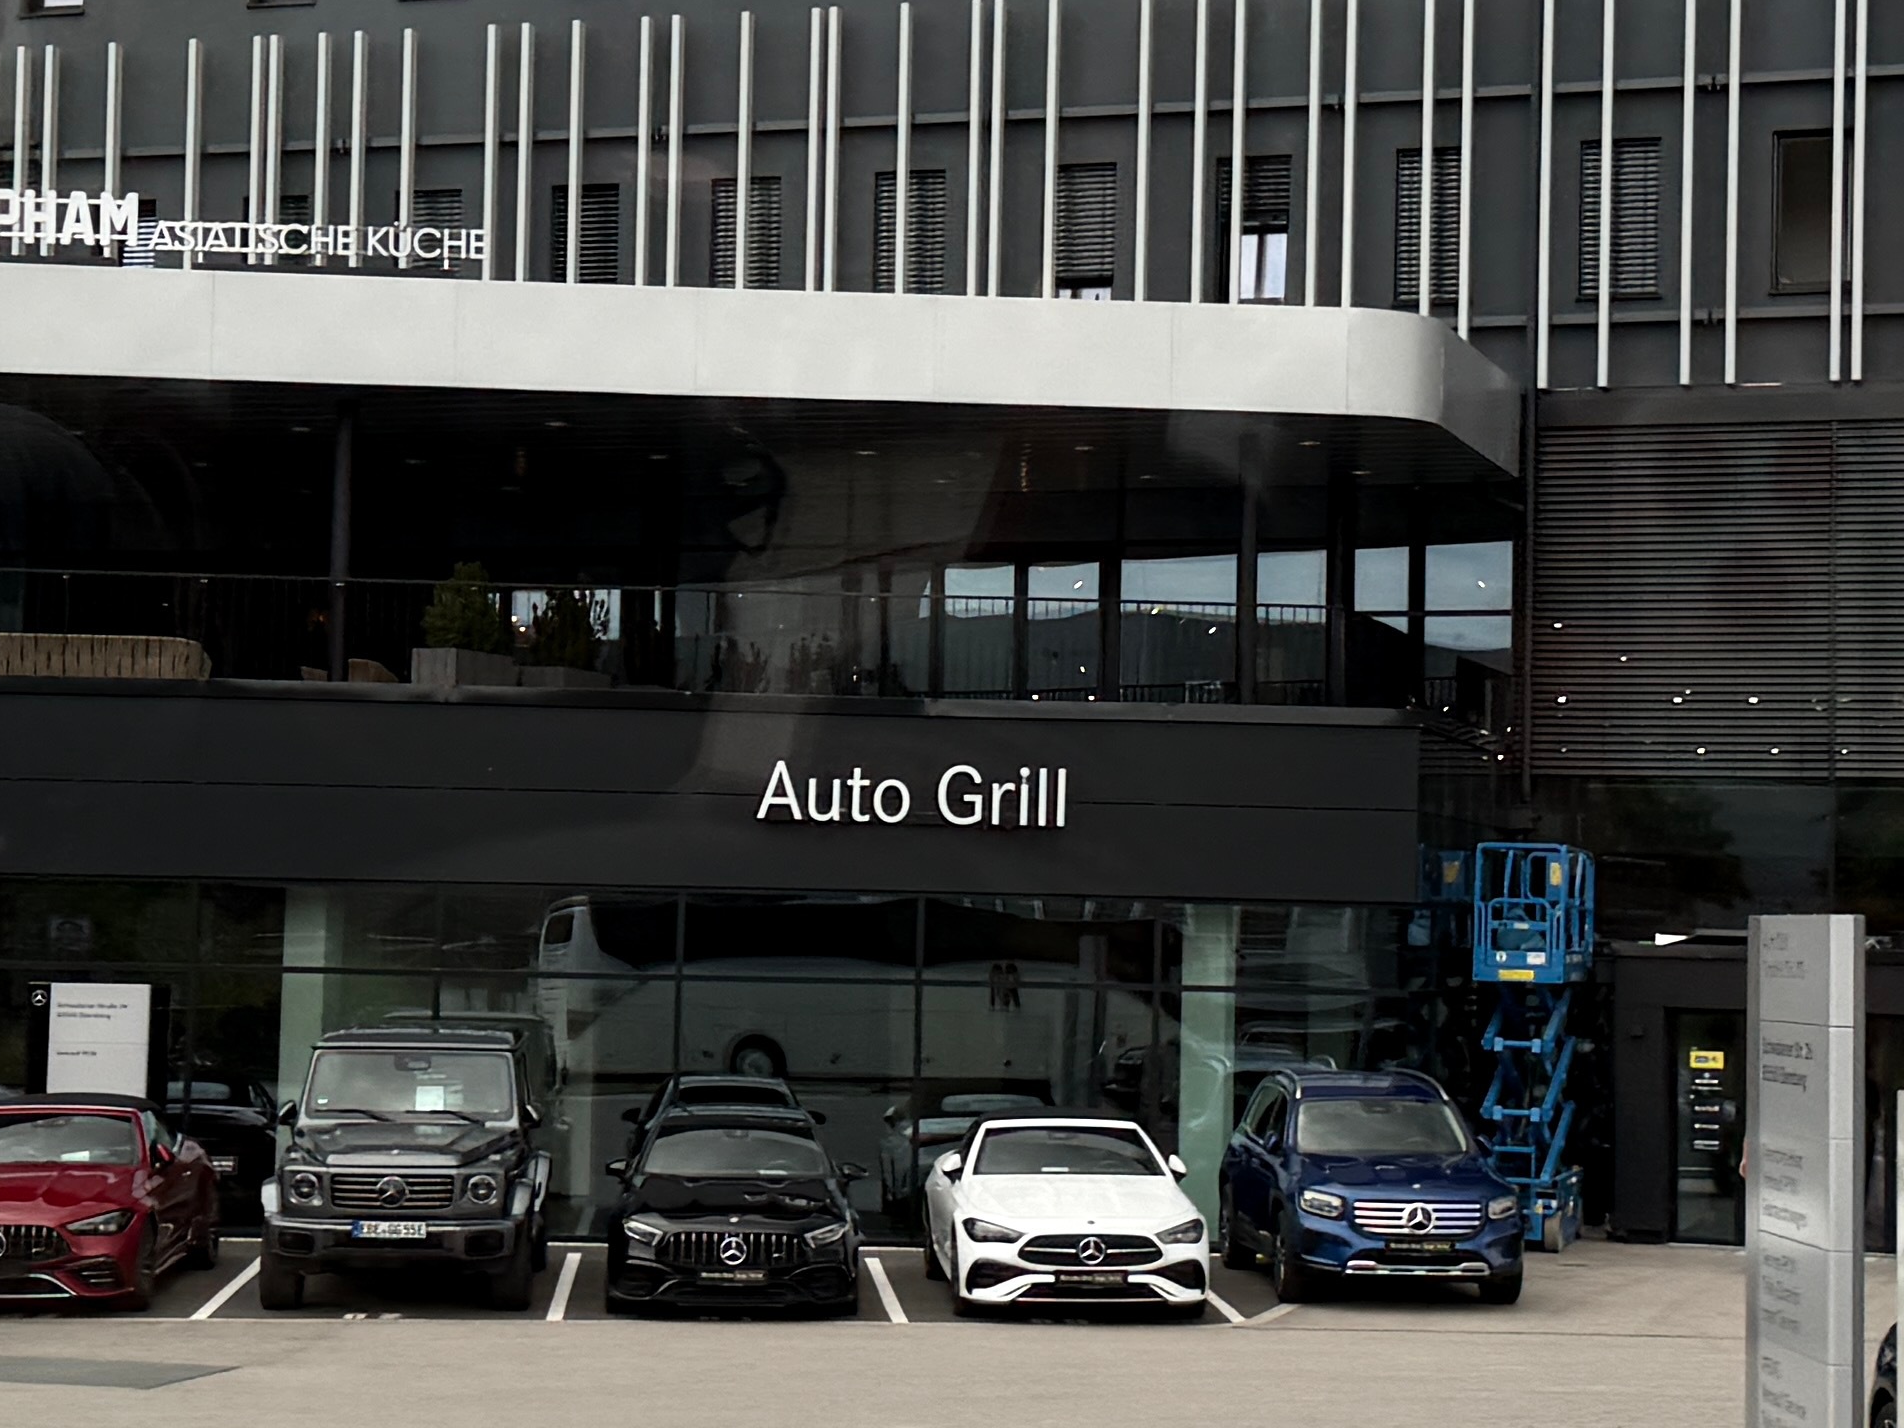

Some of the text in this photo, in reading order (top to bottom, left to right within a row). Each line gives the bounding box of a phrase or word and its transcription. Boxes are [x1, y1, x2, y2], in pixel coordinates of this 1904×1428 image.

[147, 219, 488, 260] ASIATISCHE KÜCHE
[756, 760, 1067, 827] Auto Grill
